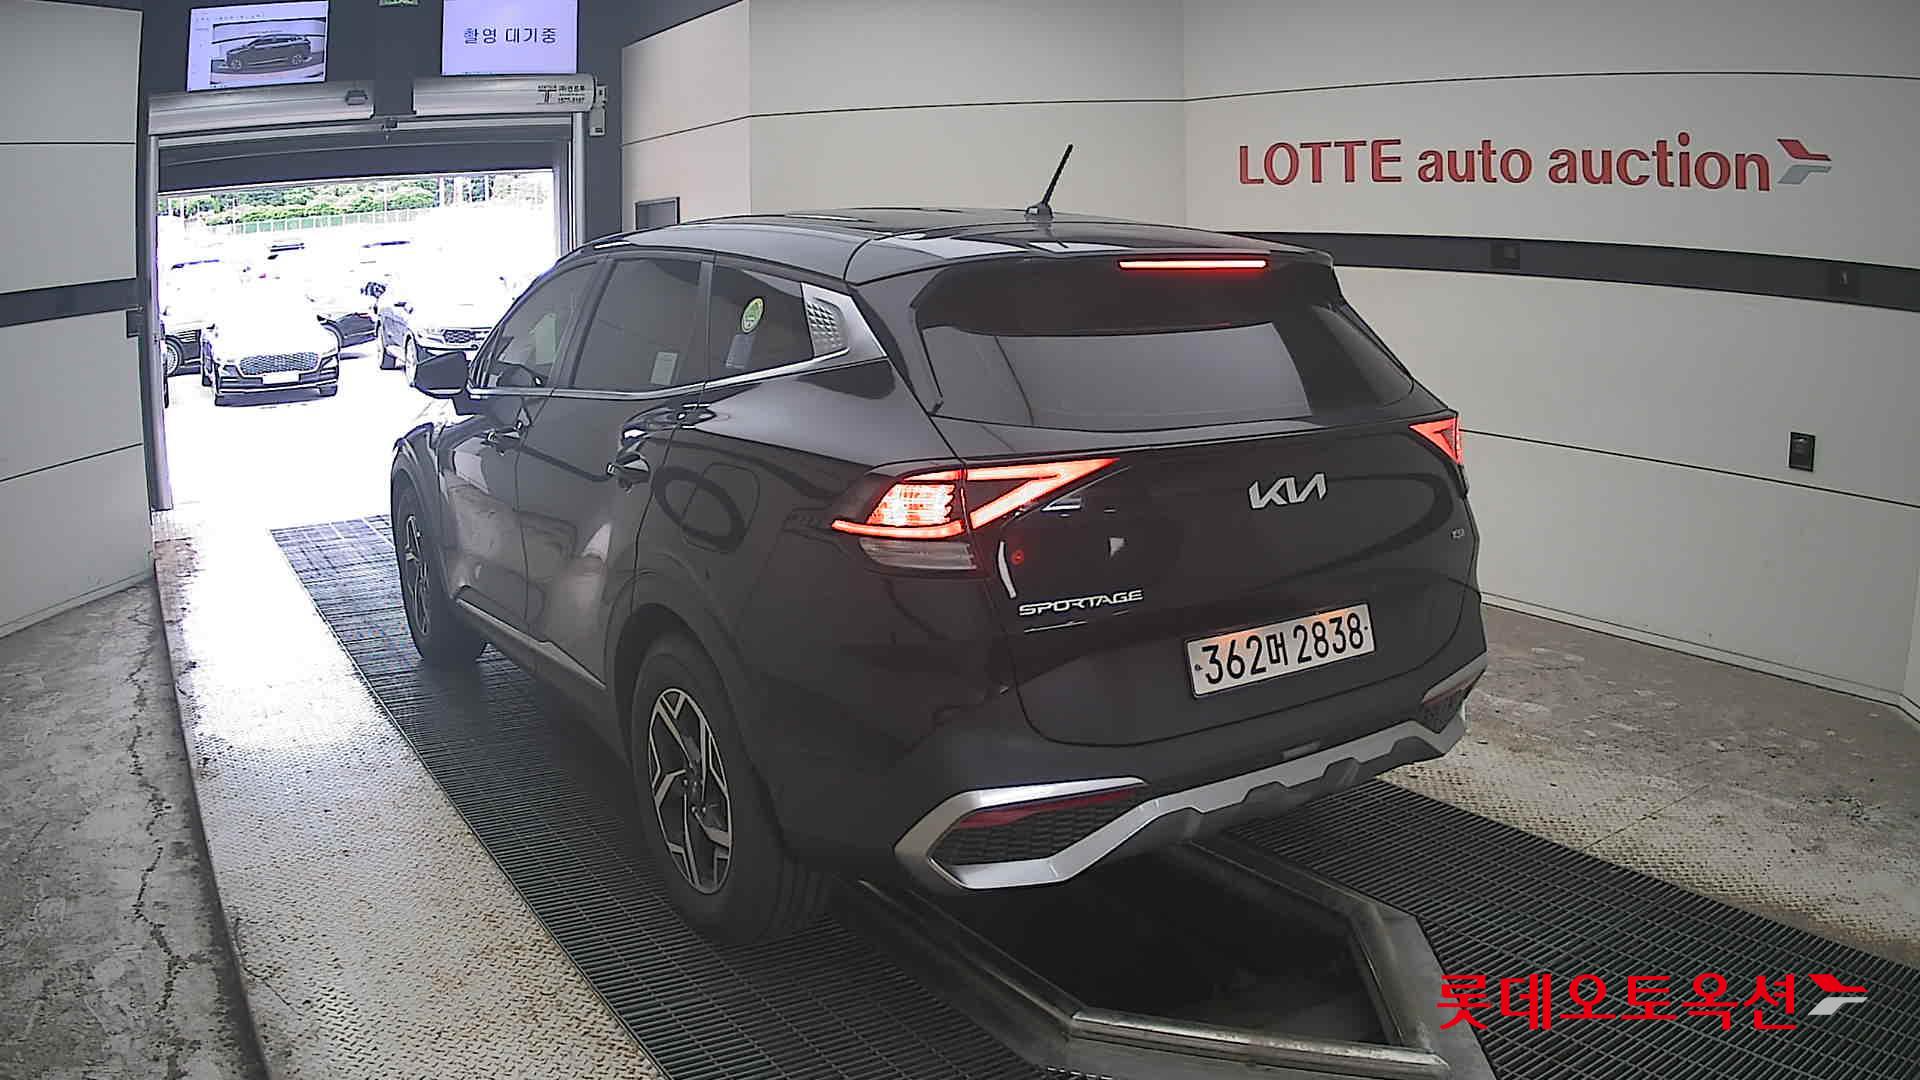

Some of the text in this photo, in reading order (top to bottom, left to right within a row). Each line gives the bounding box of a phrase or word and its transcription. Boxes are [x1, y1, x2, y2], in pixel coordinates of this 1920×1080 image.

[464, 27, 557, 44] 촬영 대기중
[1239, 132, 1771, 192] LOTTE auto auction
[1018, 588, 1145, 617] SPORTAGE
[1201, 612, 1364, 685] 362머 2838
